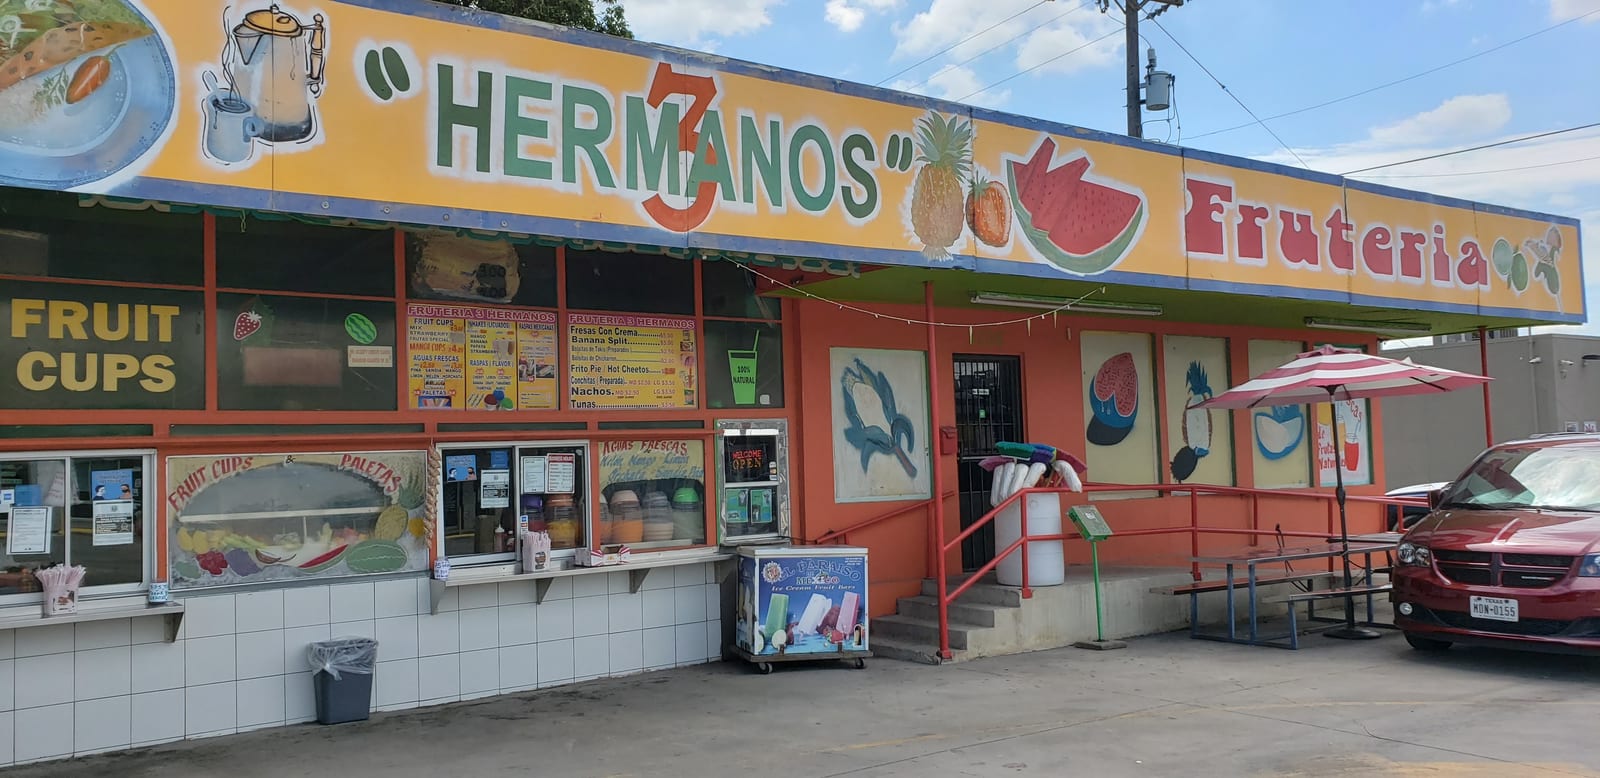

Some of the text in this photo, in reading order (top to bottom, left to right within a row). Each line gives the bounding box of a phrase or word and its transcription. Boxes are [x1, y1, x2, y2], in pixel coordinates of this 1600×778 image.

[641, 62, 717, 232] 3
[1184, 178, 1489, 286] Fruteria
[11, 298, 180, 342] FRUIT
[408, 305, 555, 322] FRUTERIA 3 HERMANOS
[436, 319, 454, 327] CUPS
[568, 314, 695, 329] FRUTERIA 3 HERMANOS
[570, 325, 597, 336] Fresas
[598, 326, 613, 336] Con
[571, 335, 606, 344] Banana
[16, 351, 177, 393] CUPS
[570, 364, 588, 374] Frito
[590, 364, 601, 373] Pie
[607, 365, 620, 374] Hot
[621, 365, 649, 374] Cheetos
[570, 375, 595, 385] Conchitas
[733, 376, 755, 384] NATURAL
[570, 399, 596, 409] Tunas
[603, 440, 689, 456] AGUAS FRESCAS
[732, 449, 763, 459] WELCOME
[285, 454, 296, 464] &
[732, 458, 763, 470] OPEN
[340, 453, 402, 493] PALETAS
[167, 455, 254, 512] FRUIT CUPS
[797, 559, 862, 582] PARAISO
